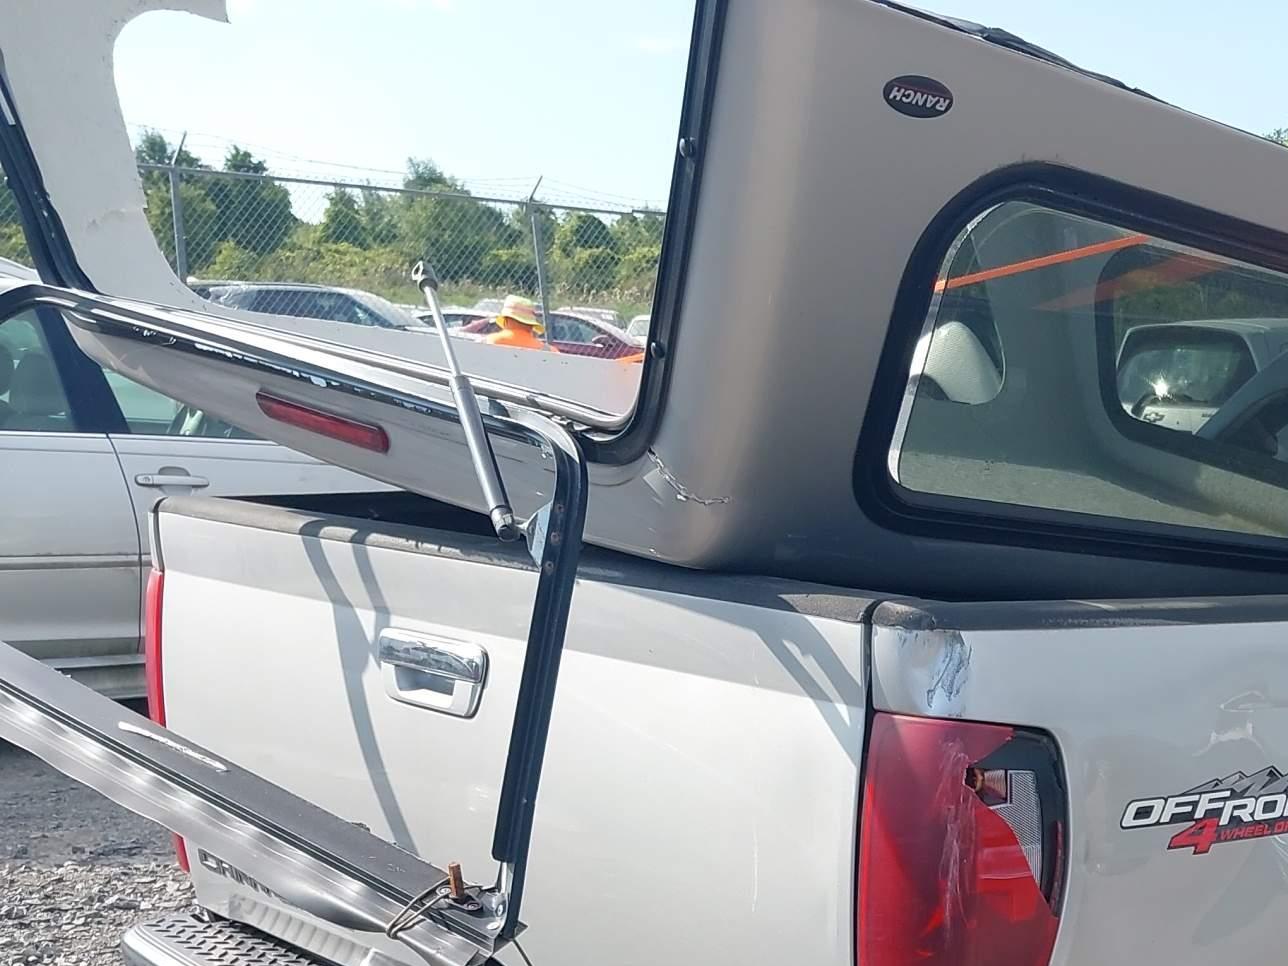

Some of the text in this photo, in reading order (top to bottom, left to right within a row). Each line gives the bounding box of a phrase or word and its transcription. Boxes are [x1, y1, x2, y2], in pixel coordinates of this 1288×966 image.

[888, 86, 950, 112] RANCH
[1167, 817, 1220, 856] 4
[1219, 824, 1272, 842] WHEEL
